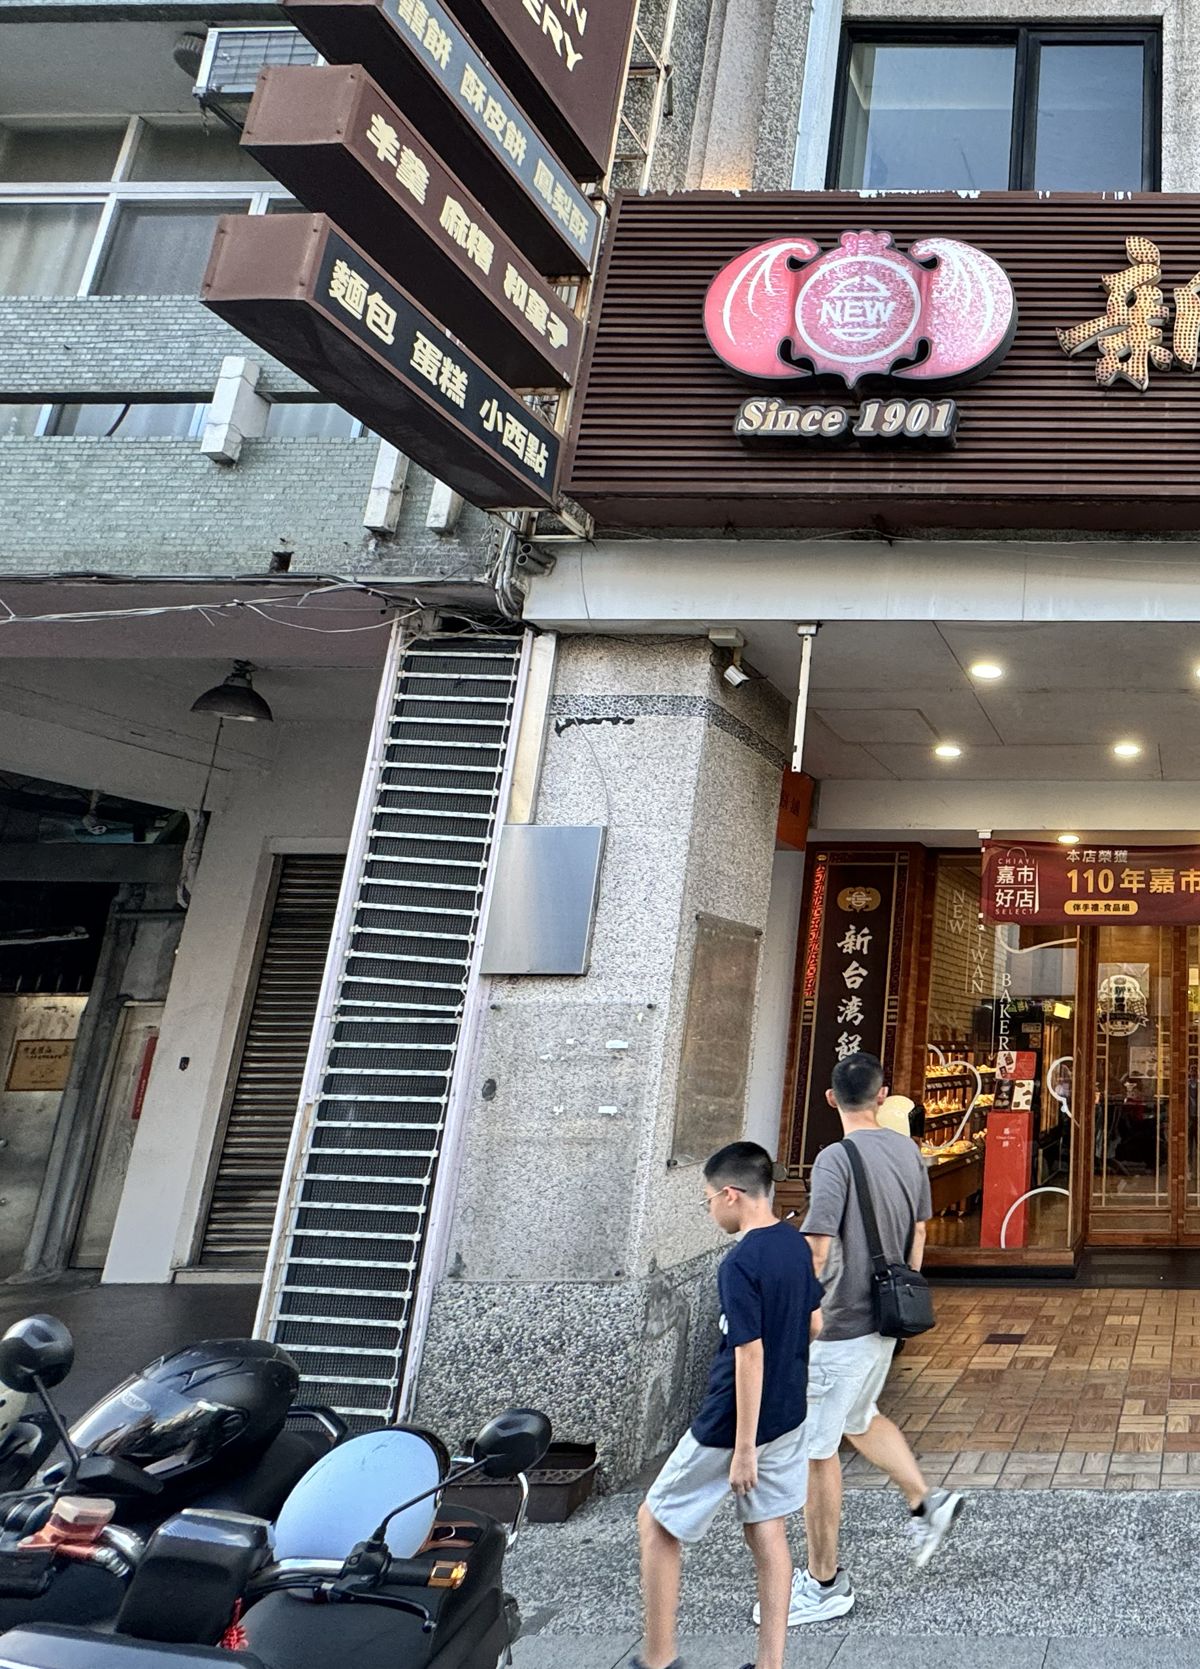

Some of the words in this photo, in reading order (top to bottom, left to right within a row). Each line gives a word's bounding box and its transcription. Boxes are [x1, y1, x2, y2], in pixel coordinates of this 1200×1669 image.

[460, 62, 527, 167] 酥皮餅
[533, 158, 588, 245] 鳳梨酥
[366, 113, 430, 205] 羊羹
[503, 262, 568, 349] 和菓子
[819, 300, 897, 323] NEW
[328, 259, 398, 346] 麵包
[410, 331, 469, 409] 蛋糕
[479, 398, 550, 479] 小西點
[737, 401, 846, 433] Since
[856, 402, 953, 433] 1901
[996, 865, 1035, 884] 嘉市
[1066, 849, 1128, 864] 本店榮獲
[948, 889, 967, 934] NEW
[995, 889, 1034, 908] 好店
[998, 973, 1012, 1051] BAKER
